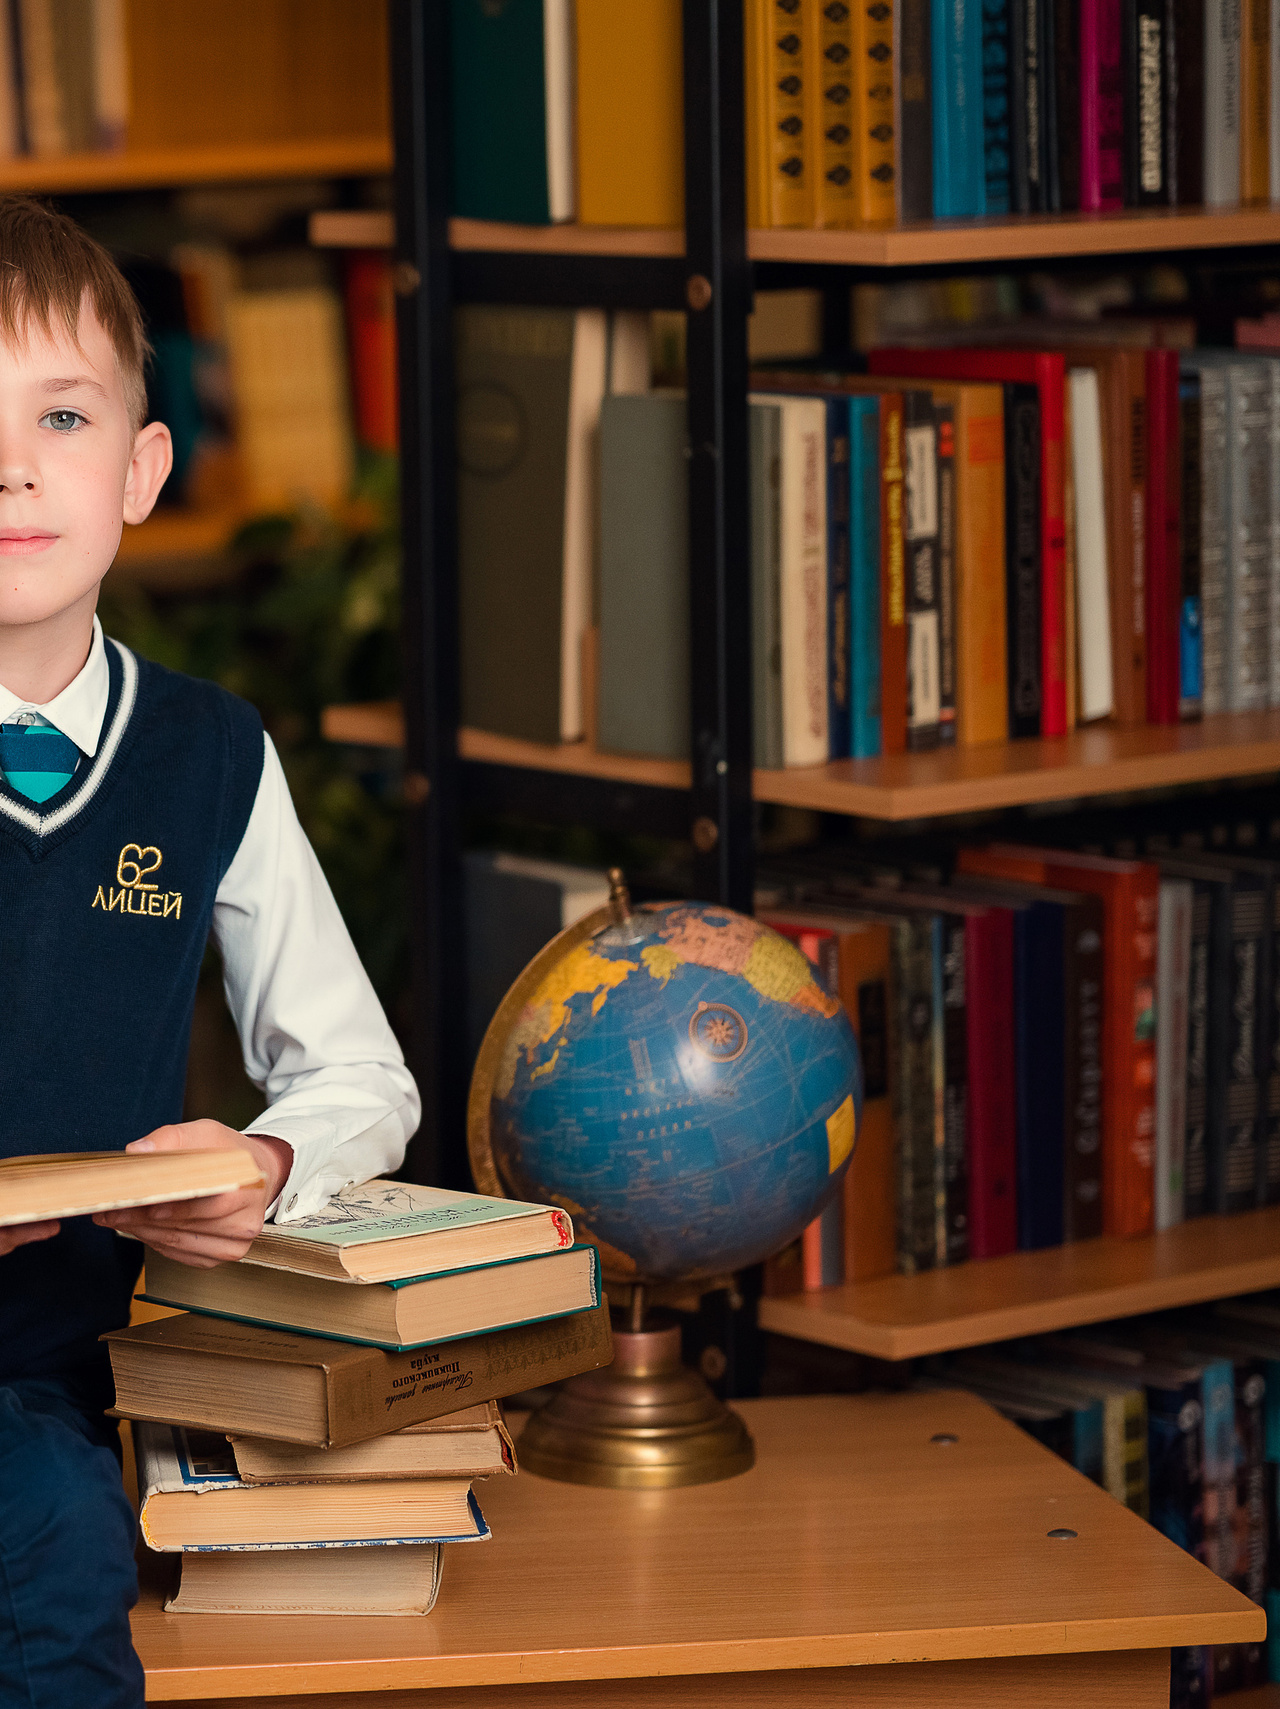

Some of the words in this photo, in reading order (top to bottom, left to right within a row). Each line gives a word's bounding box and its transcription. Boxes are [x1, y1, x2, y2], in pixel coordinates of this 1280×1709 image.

[117, 843, 163, 891] 62
[91, 885, 183, 920] ЛИЦЕЙ
[392, 1361, 461, 1389] Пиквикского
[410, 1353, 440, 1371] клуба
